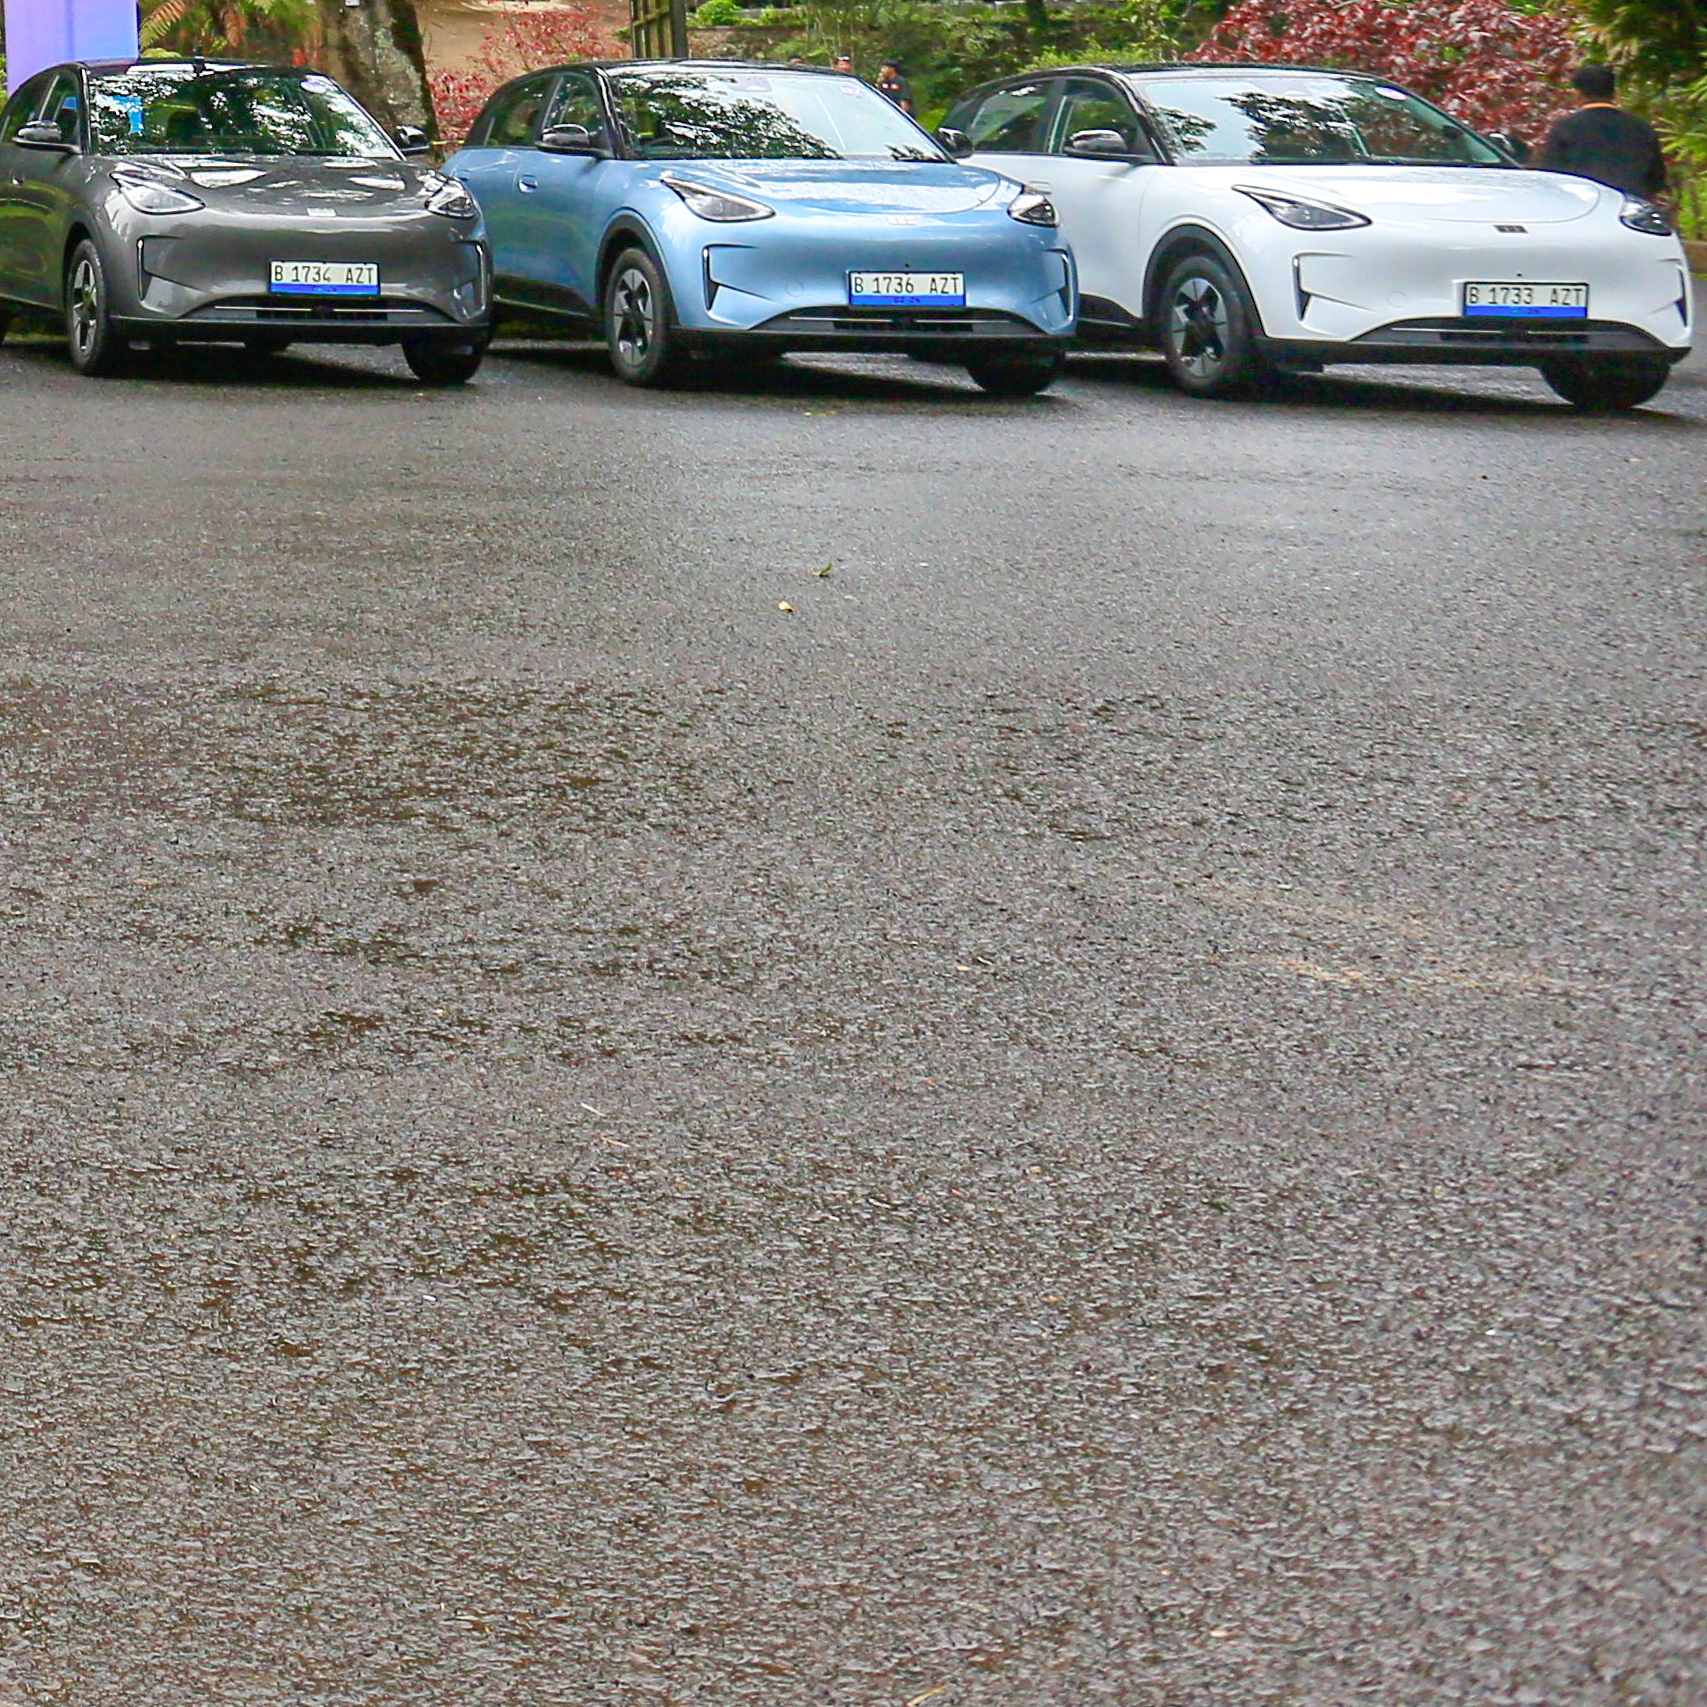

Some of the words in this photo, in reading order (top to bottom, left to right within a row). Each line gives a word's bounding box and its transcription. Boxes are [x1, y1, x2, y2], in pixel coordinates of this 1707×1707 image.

[274, 265, 283, 282] B
[291, 265, 331, 283] 1734
[345, 267, 374, 284] AZT
[854, 276, 864, 293] B
[872, 276, 914, 294] 1736
[930, 277, 959, 294] AZT
[1469, 286, 1479, 304] B
[1488, 286, 1533, 305] 1733
[1550, 288, 1583, 306] AZT
